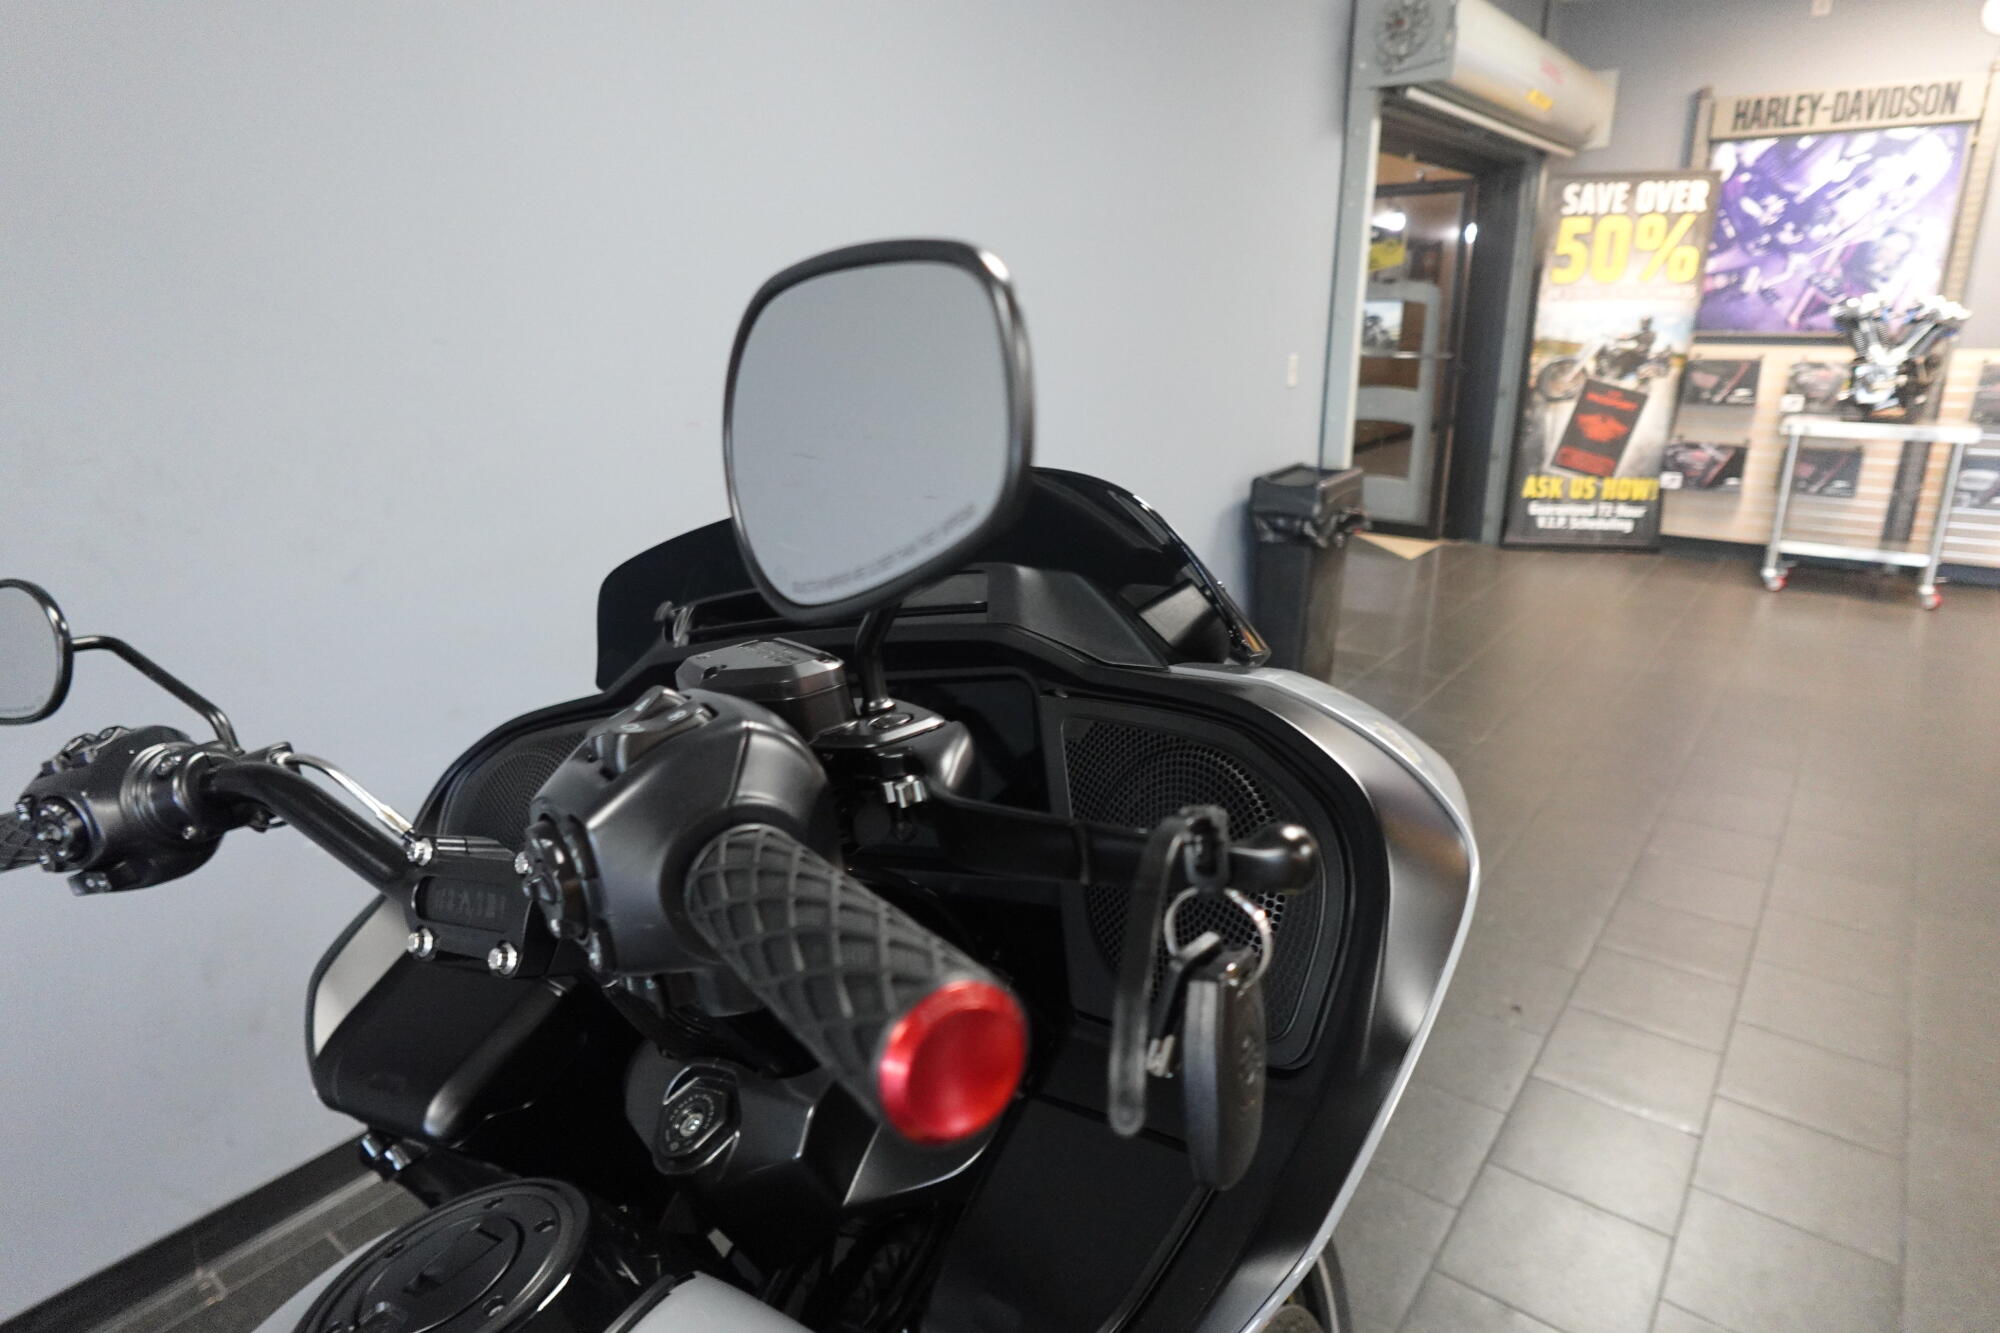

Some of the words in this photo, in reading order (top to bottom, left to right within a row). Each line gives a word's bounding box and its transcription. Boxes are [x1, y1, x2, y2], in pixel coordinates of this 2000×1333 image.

[1731, 81, 1963, 131] HARLEY-DAVIDSON
[1561, 182, 1632, 215] SAVE
[1635, 179, 1710, 214] OVER
[1551, 212, 1701, 285] 50%
[1521, 474, 1564, 498] ASK
[1568, 476, 1598, 499] US
